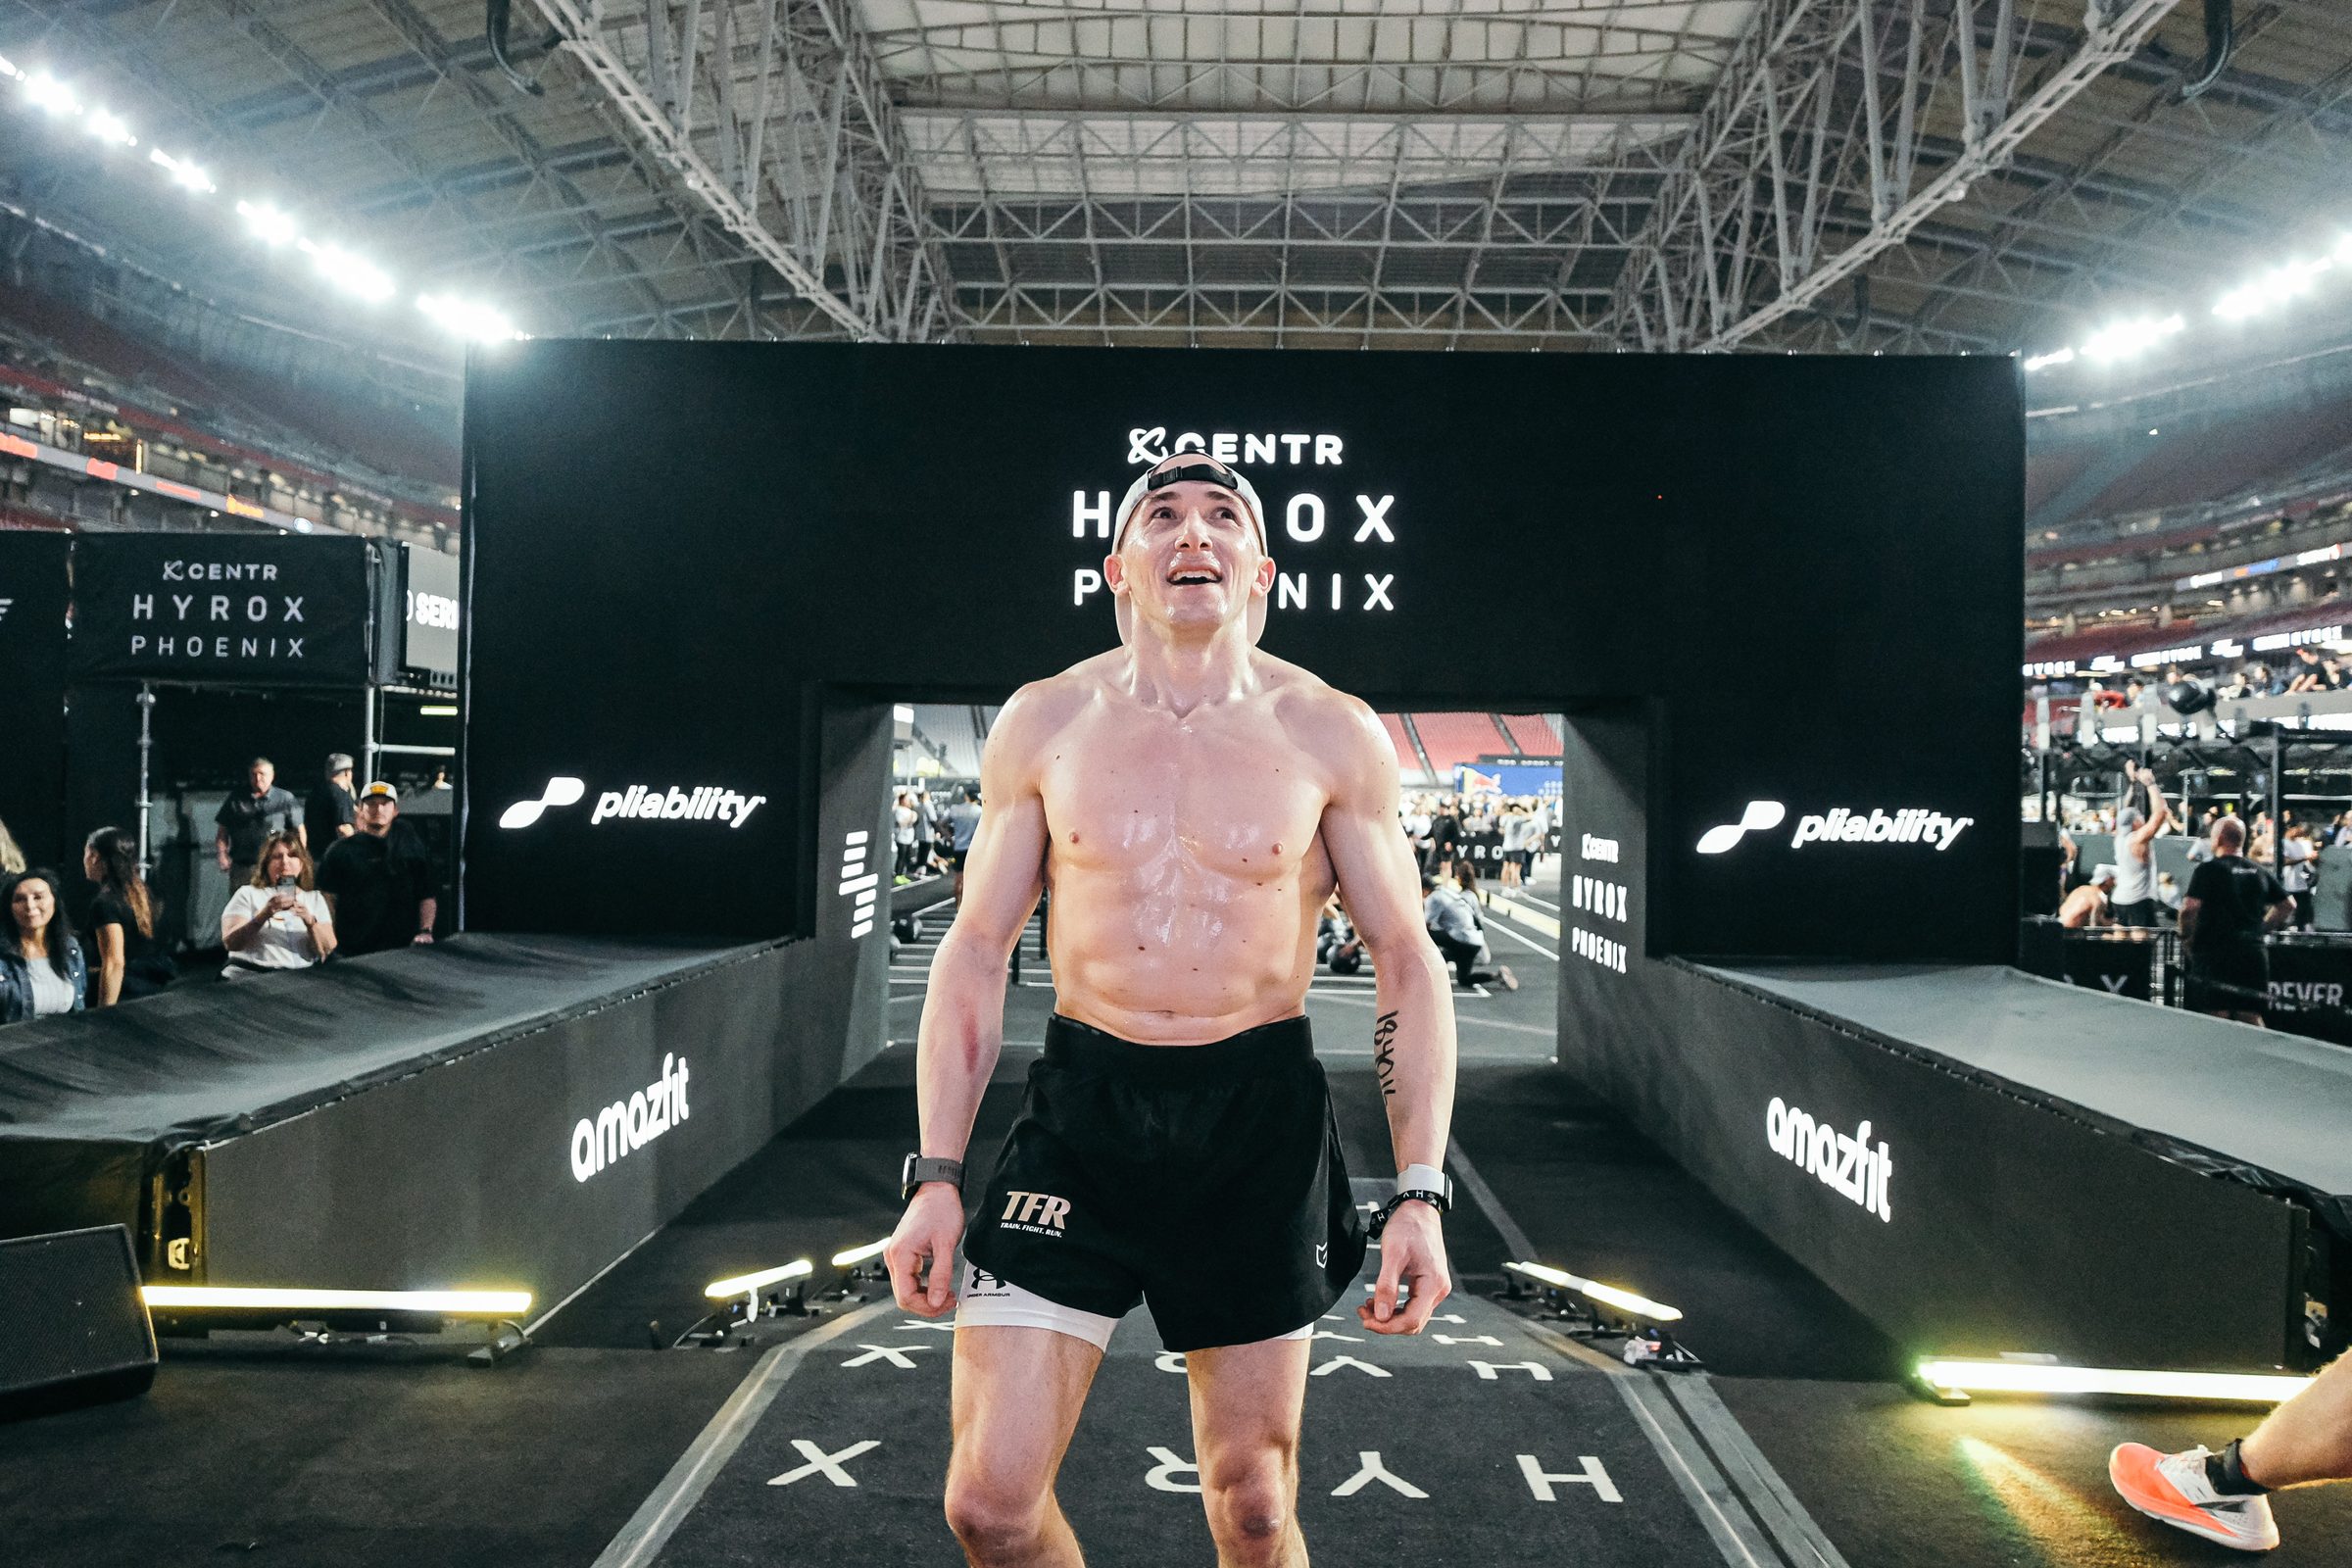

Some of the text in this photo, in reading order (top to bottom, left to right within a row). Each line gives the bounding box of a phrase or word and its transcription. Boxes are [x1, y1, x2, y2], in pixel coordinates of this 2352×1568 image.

[1072, 489, 1396, 543] HOX
[188, 563, 278, 581] CENTR
[1073, 567, 1395, 612] PNIX
[133, 594, 305, 622] HYROX
[131, 635, 304, 659] PHOENIX
[591, 784, 766, 828] pliability
[1790, 808, 1975, 851] pliability
[1572, 874, 1627, 922] HYROX
[1572, 926, 1627, 974] PHOENIX
[570, 1052, 689, 1183] amazfit
[1767, 1097, 1892, 1223] amazfit
[1000, 1222, 1062, 1239] TRAIN. FIGHT. RUN.
[1001, 1191, 1071, 1230] TFR
[767, 1437, 1625, 1504] HYRX
